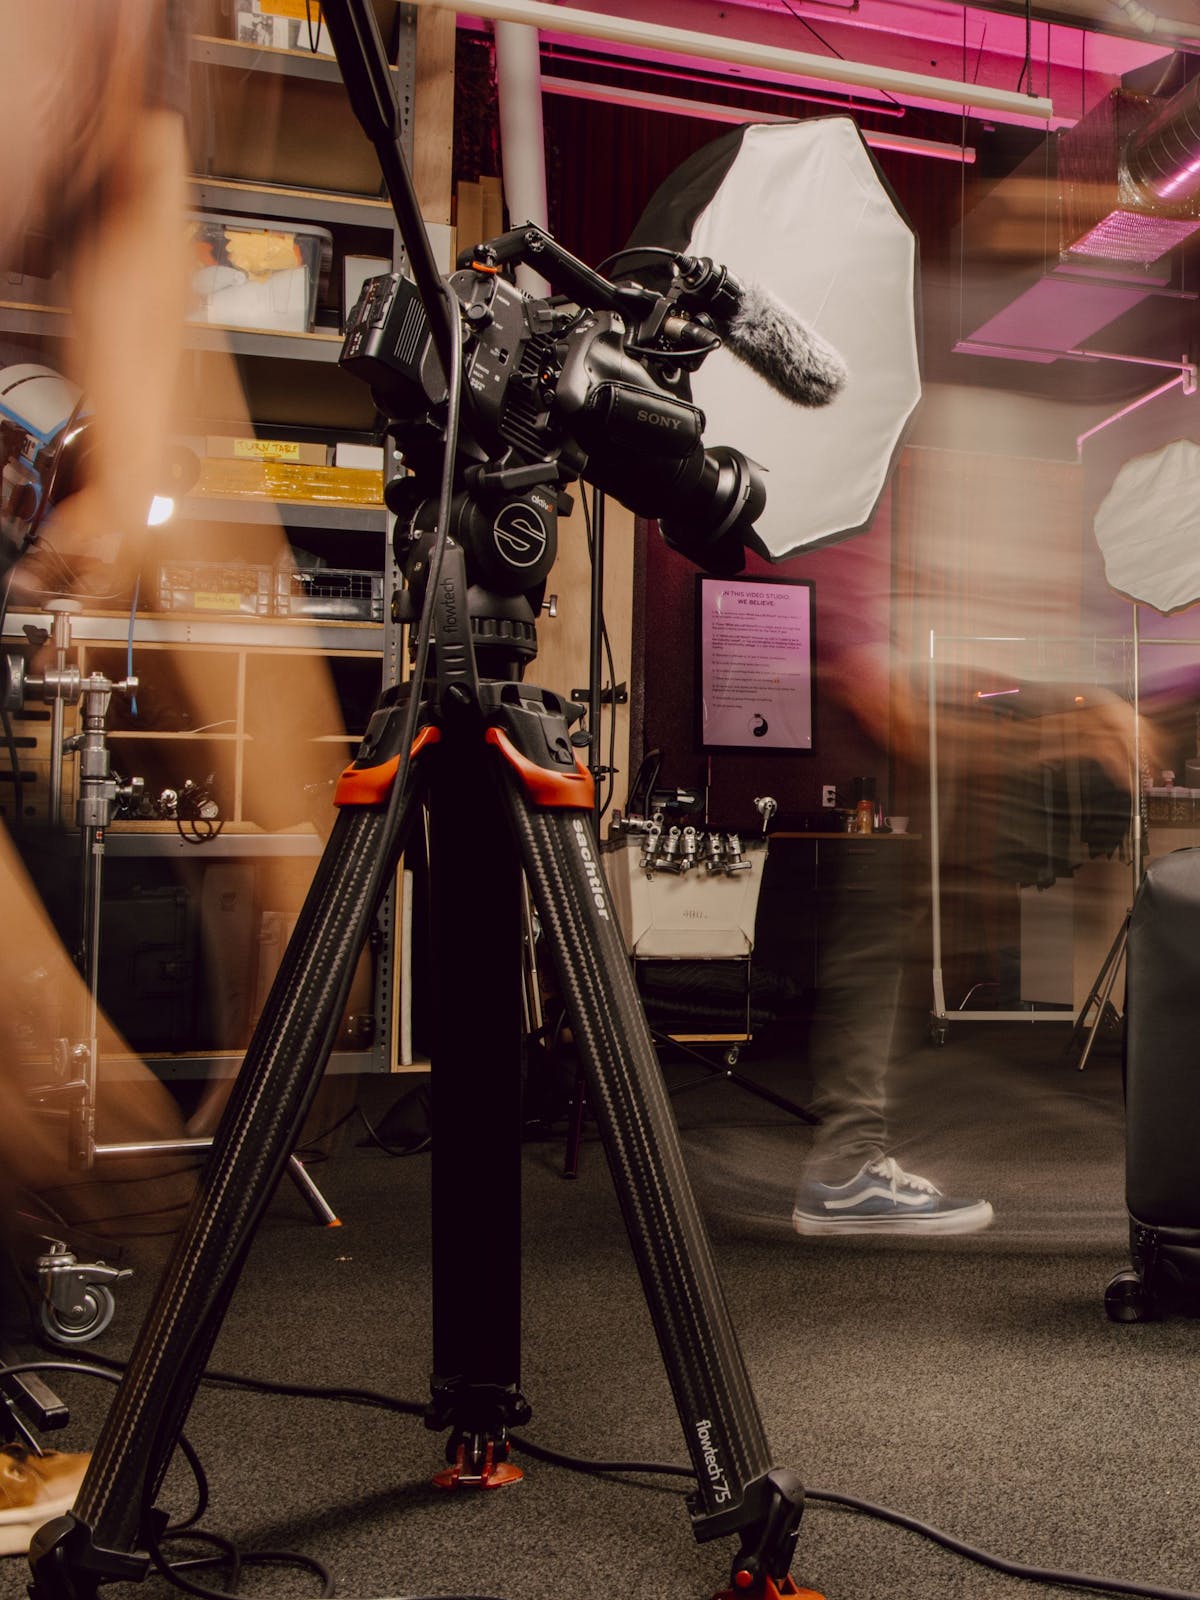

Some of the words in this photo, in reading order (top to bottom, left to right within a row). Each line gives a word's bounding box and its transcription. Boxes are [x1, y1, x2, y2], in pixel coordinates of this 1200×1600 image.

[637, 409, 682, 431] SONY
[440, 578, 457, 634] flowtech
[573, 819, 609, 920] sachtler
[696, 1419, 724, 1481] flowtech
[713, 1480, 732, 1504] 75
